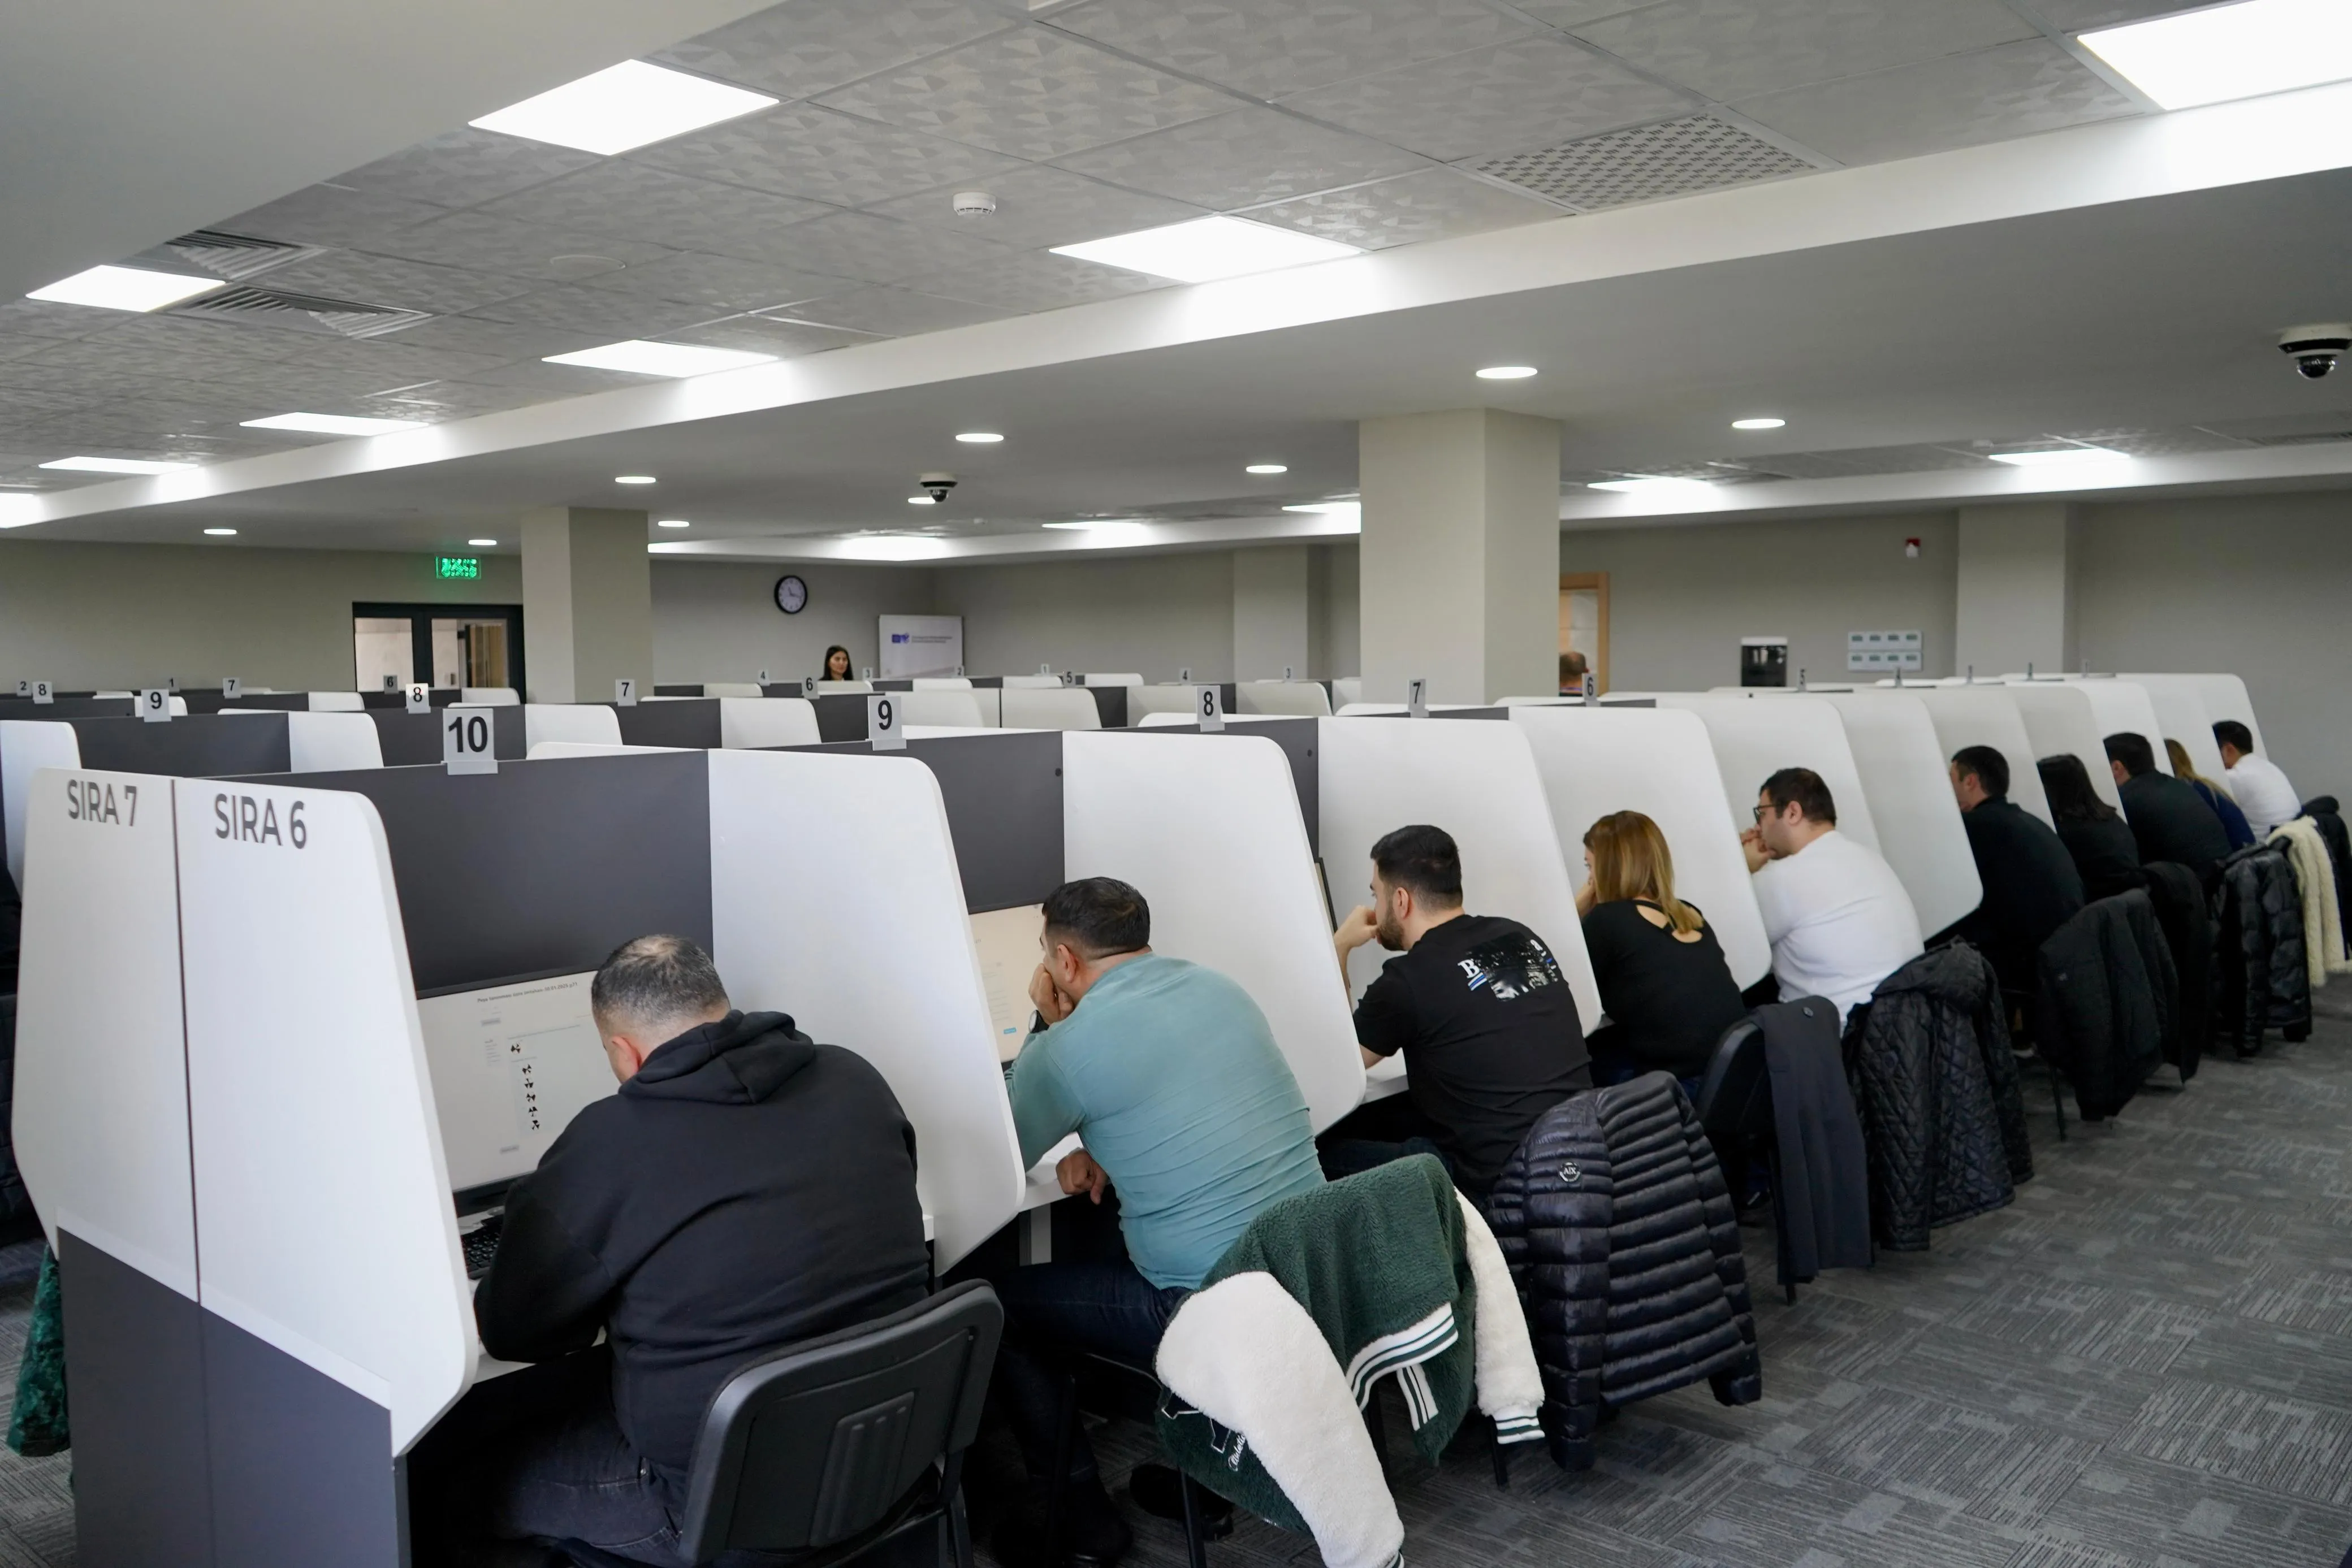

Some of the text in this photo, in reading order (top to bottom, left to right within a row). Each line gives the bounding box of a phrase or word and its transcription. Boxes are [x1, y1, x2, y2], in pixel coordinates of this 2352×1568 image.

[170, 678, 174, 687] 1
[760, 671, 766, 680] 4
[1067, 671, 1073, 683] 5
[20, 681, 27, 691] 2
[38, 684, 46, 696] 8
[228, 679, 235, 691] 7
[621, 682, 630, 697] 7
[806, 677, 813, 691] 6
[1587, 677, 1593, 696] 6
[150, 691, 162, 709] 9
[413, 687, 422, 702] 8
[1413, 682, 1421, 704] 7
[1204, 691, 1214, 716] 8
[878, 700, 893, 730] 9
[448, 716, 488, 753] 10
[67, 779, 137, 827] SIRA 7
[214, 793, 307, 850] SIRA 6
